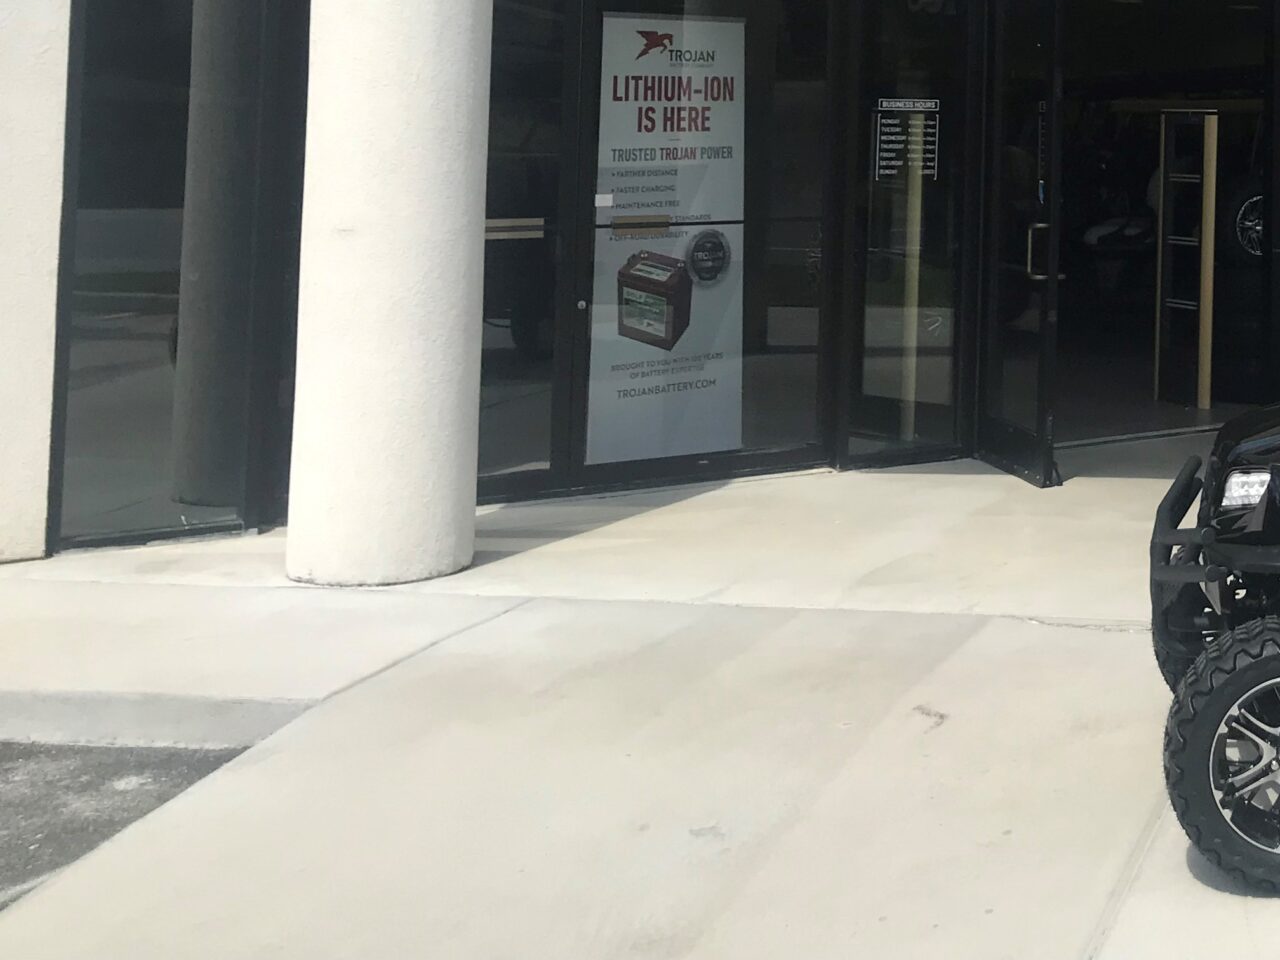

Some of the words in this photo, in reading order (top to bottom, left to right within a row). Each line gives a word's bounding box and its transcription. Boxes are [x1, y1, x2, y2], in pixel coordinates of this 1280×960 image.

[668, 49, 715, 62] TROJAN
[612, 75, 735, 101] LITHIUM-ION
[637, 106, 656, 132] IS
[662, 106, 711, 132] HERE
[611, 148, 657, 162] TRUSTED
[660, 146, 697, 161] TROJAN
[700, 146, 733, 160] POWER
[647, 168, 678, 177] DISTANCE
[641, 185, 676, 193] CHARGING
[615, 201, 663, 209] MAINTENANCE
[664, 200, 680, 208] FREE
[611, 360, 645, 372] BROUGHT
[646, 359, 656, 368] TO
[629, 372, 641, 380] OF
[641, 368, 670, 378] BATTERY
[616, 378, 717, 400] TROJANBATTERY.COM
